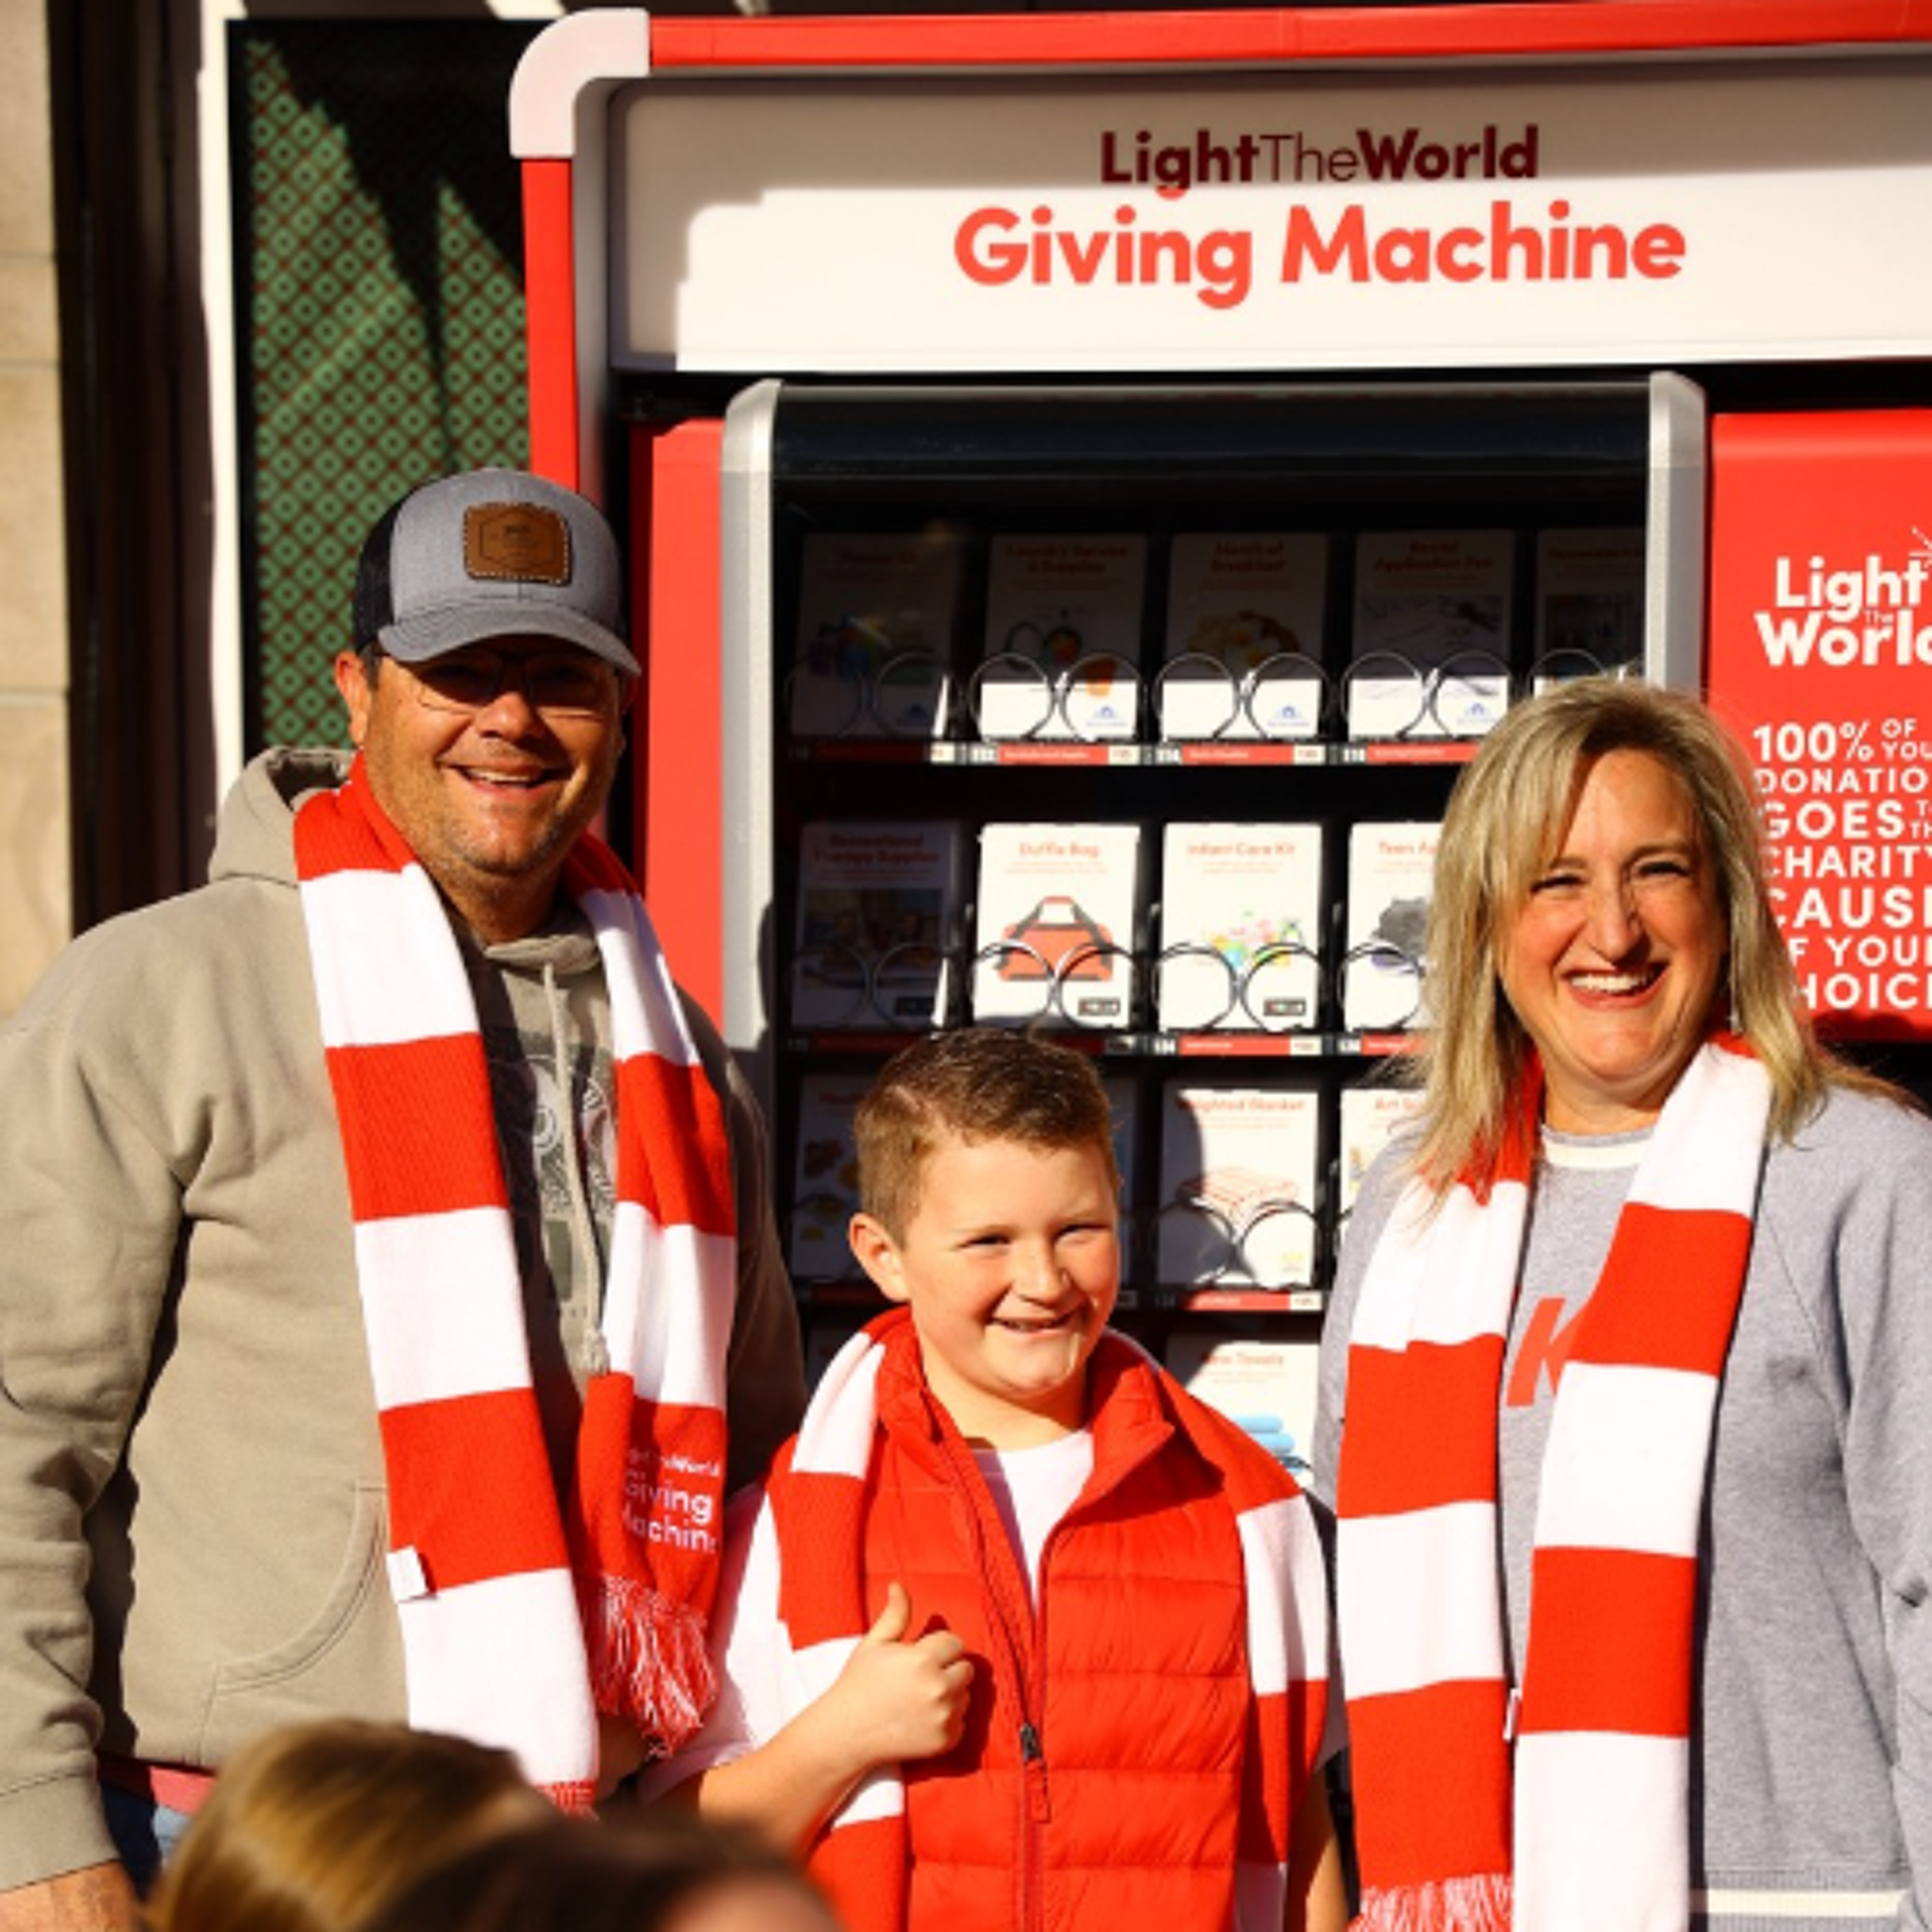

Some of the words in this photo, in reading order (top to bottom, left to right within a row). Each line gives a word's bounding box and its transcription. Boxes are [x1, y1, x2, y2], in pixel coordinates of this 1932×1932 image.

[954, 205, 1251, 309] Giving
[1281, 200, 1685, 282] Machine
[1776, 554, 1929, 623] Light
[1752, 720, 1873, 762] 100%
[1880, 717, 1917, 739] OF
[1762, 799, 1905, 839] GOES
[1070, 841, 1100, 859] Bag
[1236, 842, 1272, 855] Care
[1274, 842, 1295, 855] Kit
[1799, 972, 1932, 1009] HOIC
